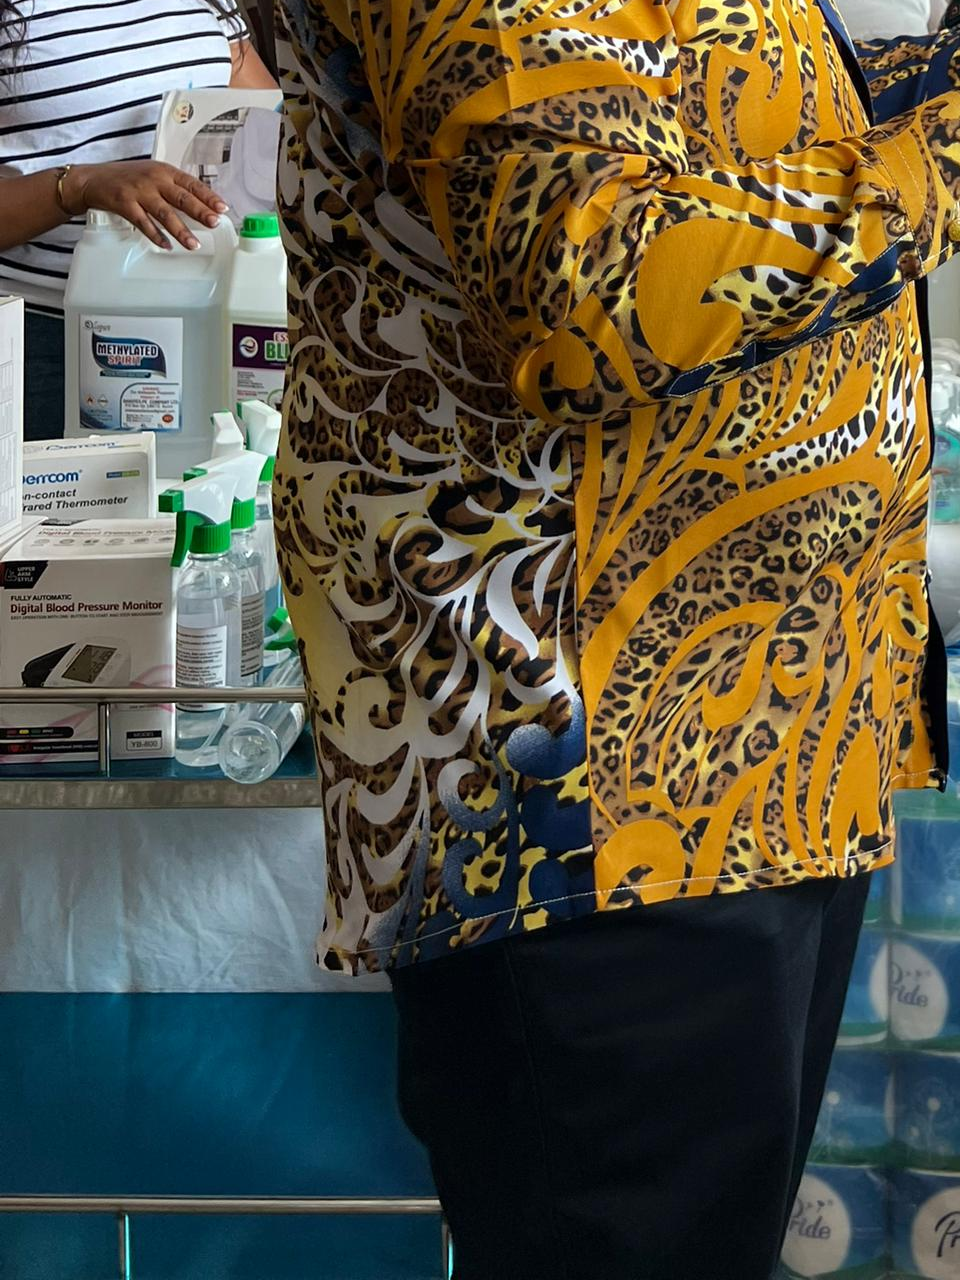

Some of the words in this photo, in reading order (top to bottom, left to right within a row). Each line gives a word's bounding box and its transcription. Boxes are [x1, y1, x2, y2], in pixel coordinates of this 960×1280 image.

[97, 342, 159, 358] METHYLATED
[107, 356, 142, 367] SPIRIT
[22, 502, 52, 512] rared
[56, 496, 128, 509] Thermometer
[32, 594, 72, 602] AUTOMATIC
[10, 602, 43, 615] Digital
[46, 602, 74, 612] Blood
[78, 602, 120, 612] Pressure
[122, 600, 163, 611] Monitor
